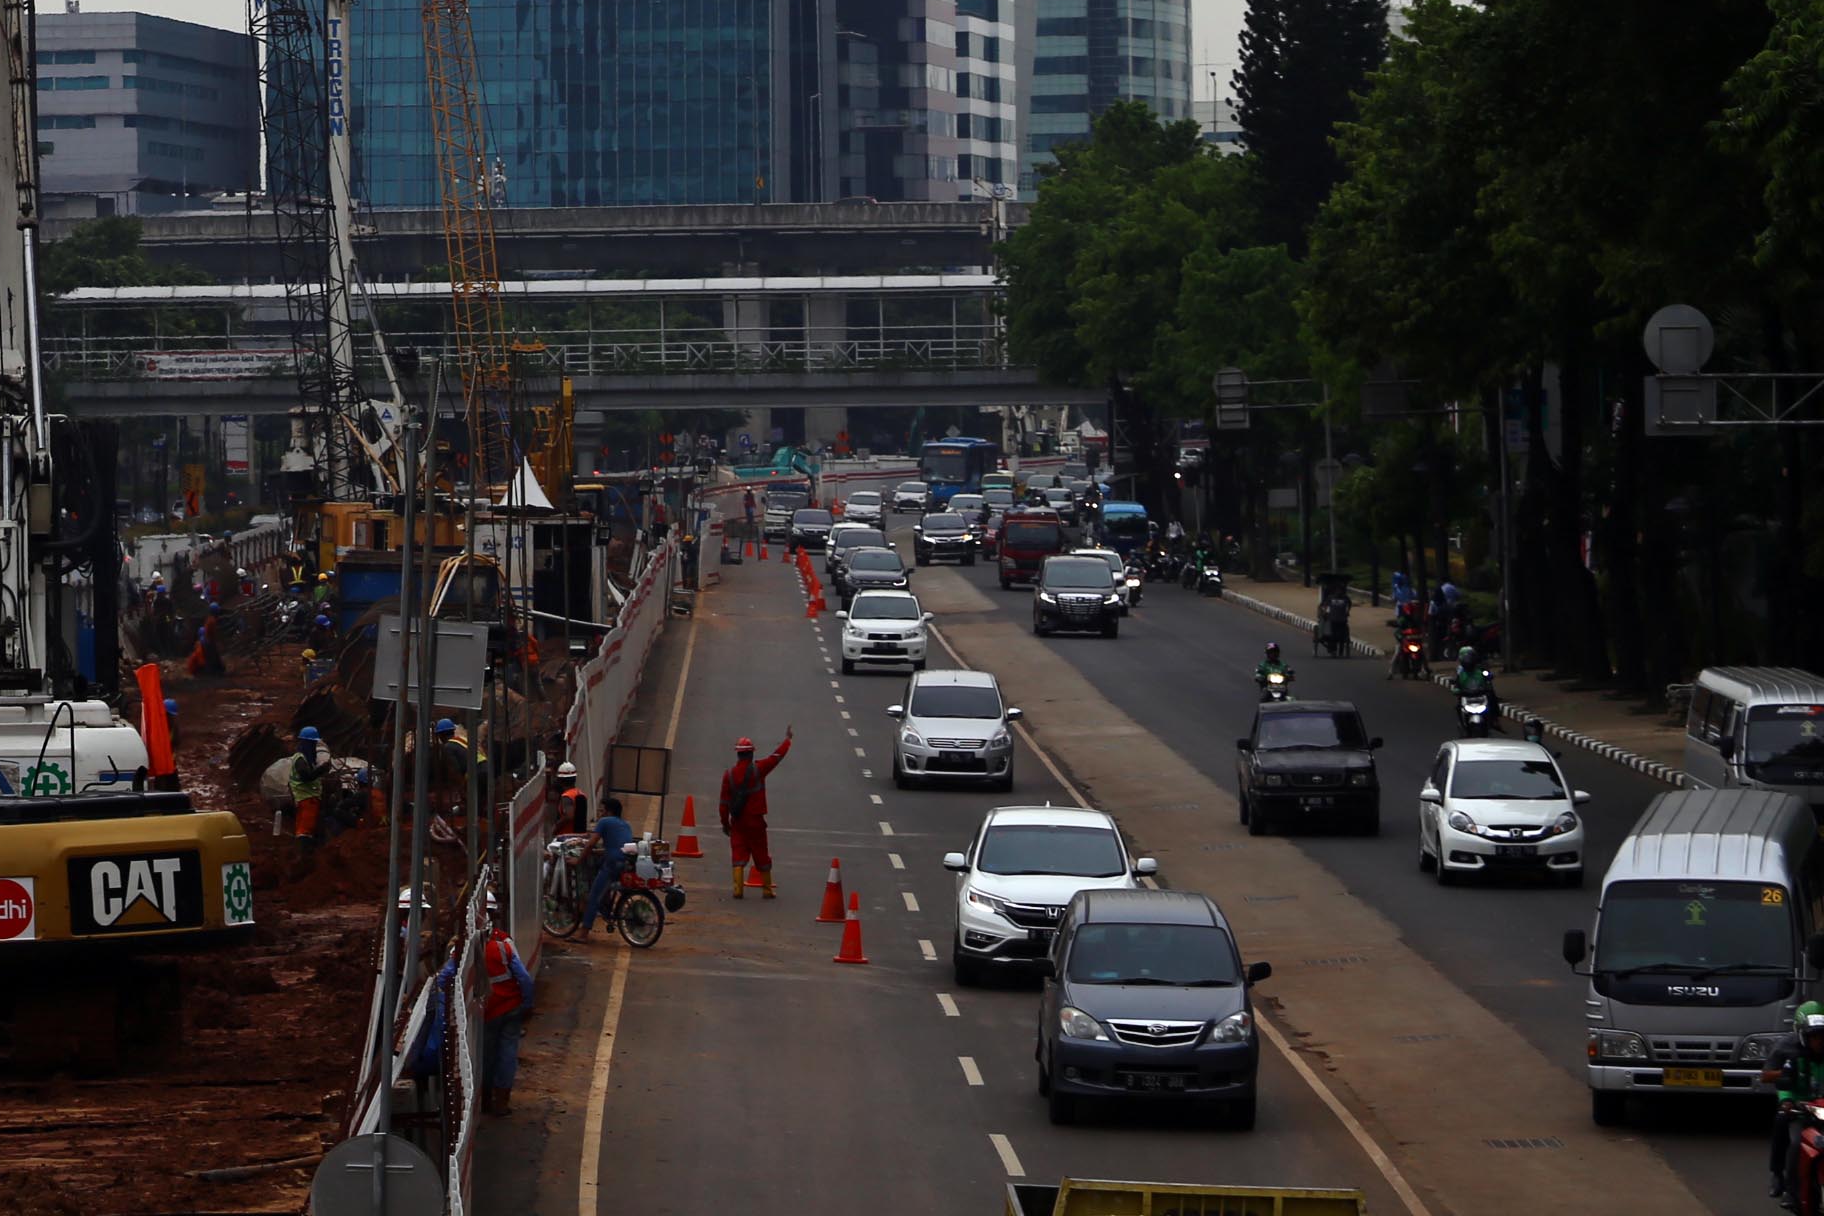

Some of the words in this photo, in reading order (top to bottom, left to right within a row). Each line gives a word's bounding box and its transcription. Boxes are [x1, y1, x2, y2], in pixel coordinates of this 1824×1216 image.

[328, 19, 344, 137] TROCON
[90, 856, 182, 927] CAT
[1762, 889, 1784, 903] 26
[1667, 986, 1720, 997] ISUZU
